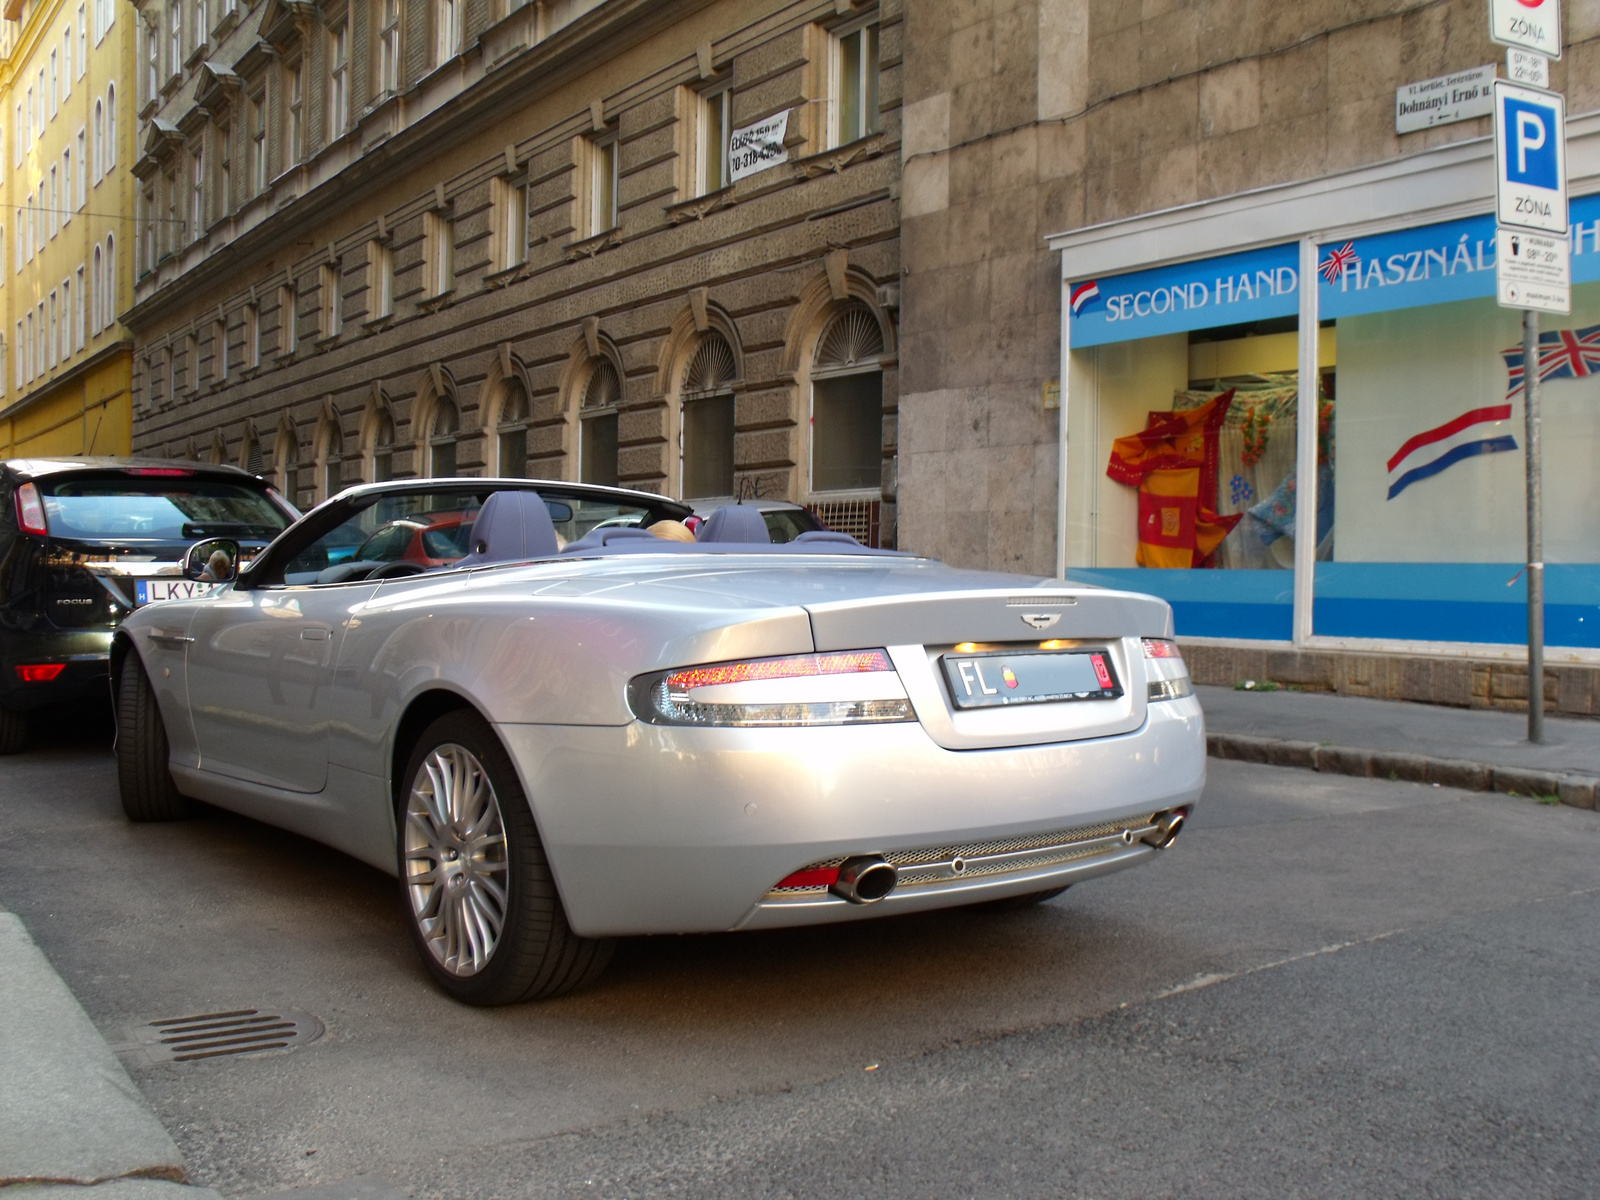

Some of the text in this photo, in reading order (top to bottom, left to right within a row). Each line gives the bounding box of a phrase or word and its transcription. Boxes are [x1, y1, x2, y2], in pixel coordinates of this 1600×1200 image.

[1509, 16, 1546, 44] ZÓNA
[1446, 70, 1484, 87] Terézváros
[1399, 85, 1492, 117] Dohnányi Ernő u.
[1429, 115, 1434, 125] 2
[1517, 110, 1546, 173] P
[1515, 195, 1552, 217] ZÓNA
[1105, 266, 1298, 322] SECOND HAND
[957, 661, 998, 696] FL
